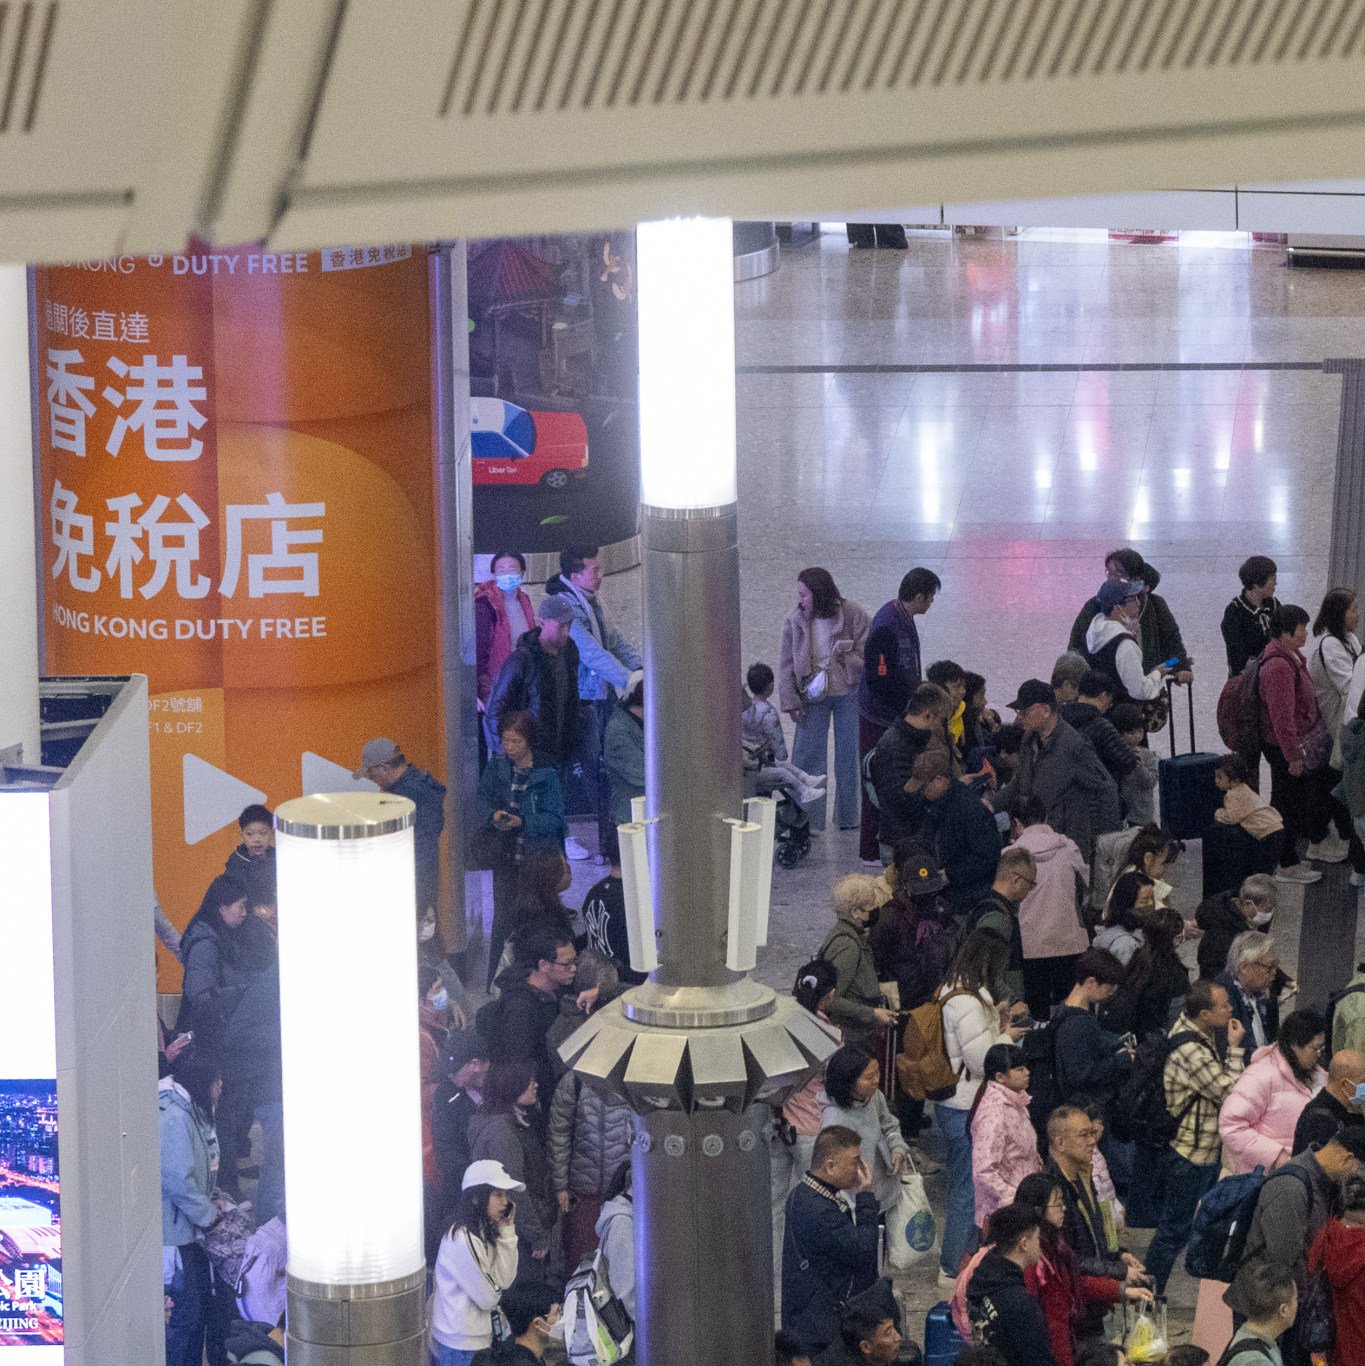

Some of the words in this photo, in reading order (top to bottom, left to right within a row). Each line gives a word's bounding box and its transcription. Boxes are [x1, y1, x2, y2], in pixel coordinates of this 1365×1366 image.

[173, 253, 240, 276] DUTY
[247, 252, 309, 273] FREE
[46, 348, 209, 464] 香港
[488, 465, 505, 475] Uber
[49, 480, 327, 602] 免稅店
[52, 604, 91, 634] HONG
[94, 613, 169, 640] KONG
[174, 618, 254, 641] DUTY
[259, 616, 328, 640] FREE
[163, 721, 174, 734] &
[176, 721, 203, 735] DF2
[12, 1301, 37, 1312] Park
